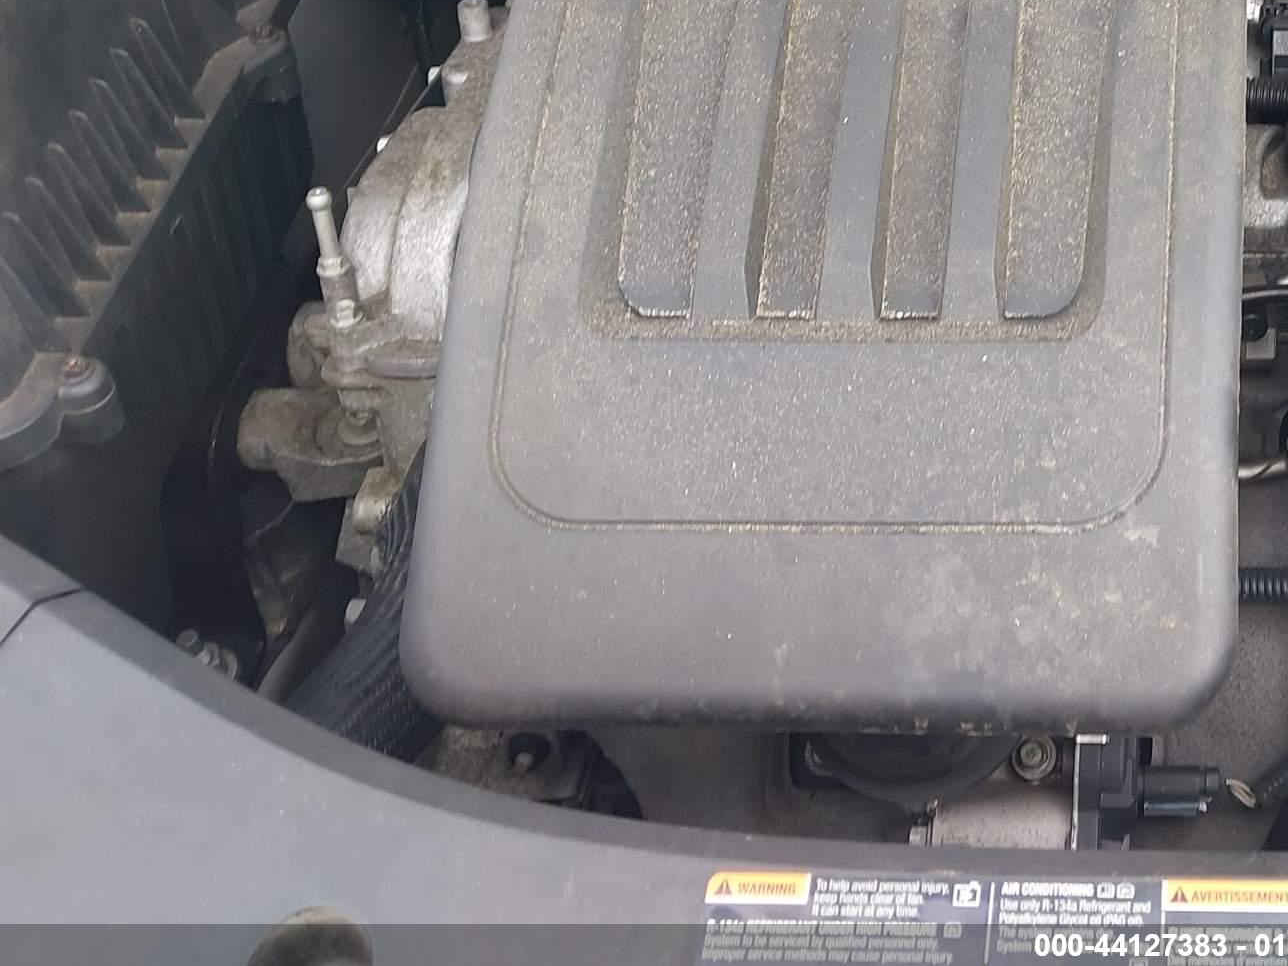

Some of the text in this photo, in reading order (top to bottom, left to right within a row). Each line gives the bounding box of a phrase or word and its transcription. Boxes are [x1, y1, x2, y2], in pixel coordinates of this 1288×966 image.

[738, 882, 796, 896] WARNING
[817, 878, 828, 892] To
[828, 879, 850, 894] help
[851, 880, 878, 892] avoid
[878, 881, 920, 895] personal
[1001, 882, 1095, 898] AIR CONDITIONING
[814, 891, 838, 905] keep
[839, 892, 869, 905] hands
[869, 893, 895, 905] clear
[895, 893, 907, 905] of
[820, 905, 839, 916] can
[840, 905, 863, 917] start
[864, 905, 876, 917] at
[876, 907, 896, 919] any
[1000, 898, 1151, 915] Use only R-134a Refrigerant and
